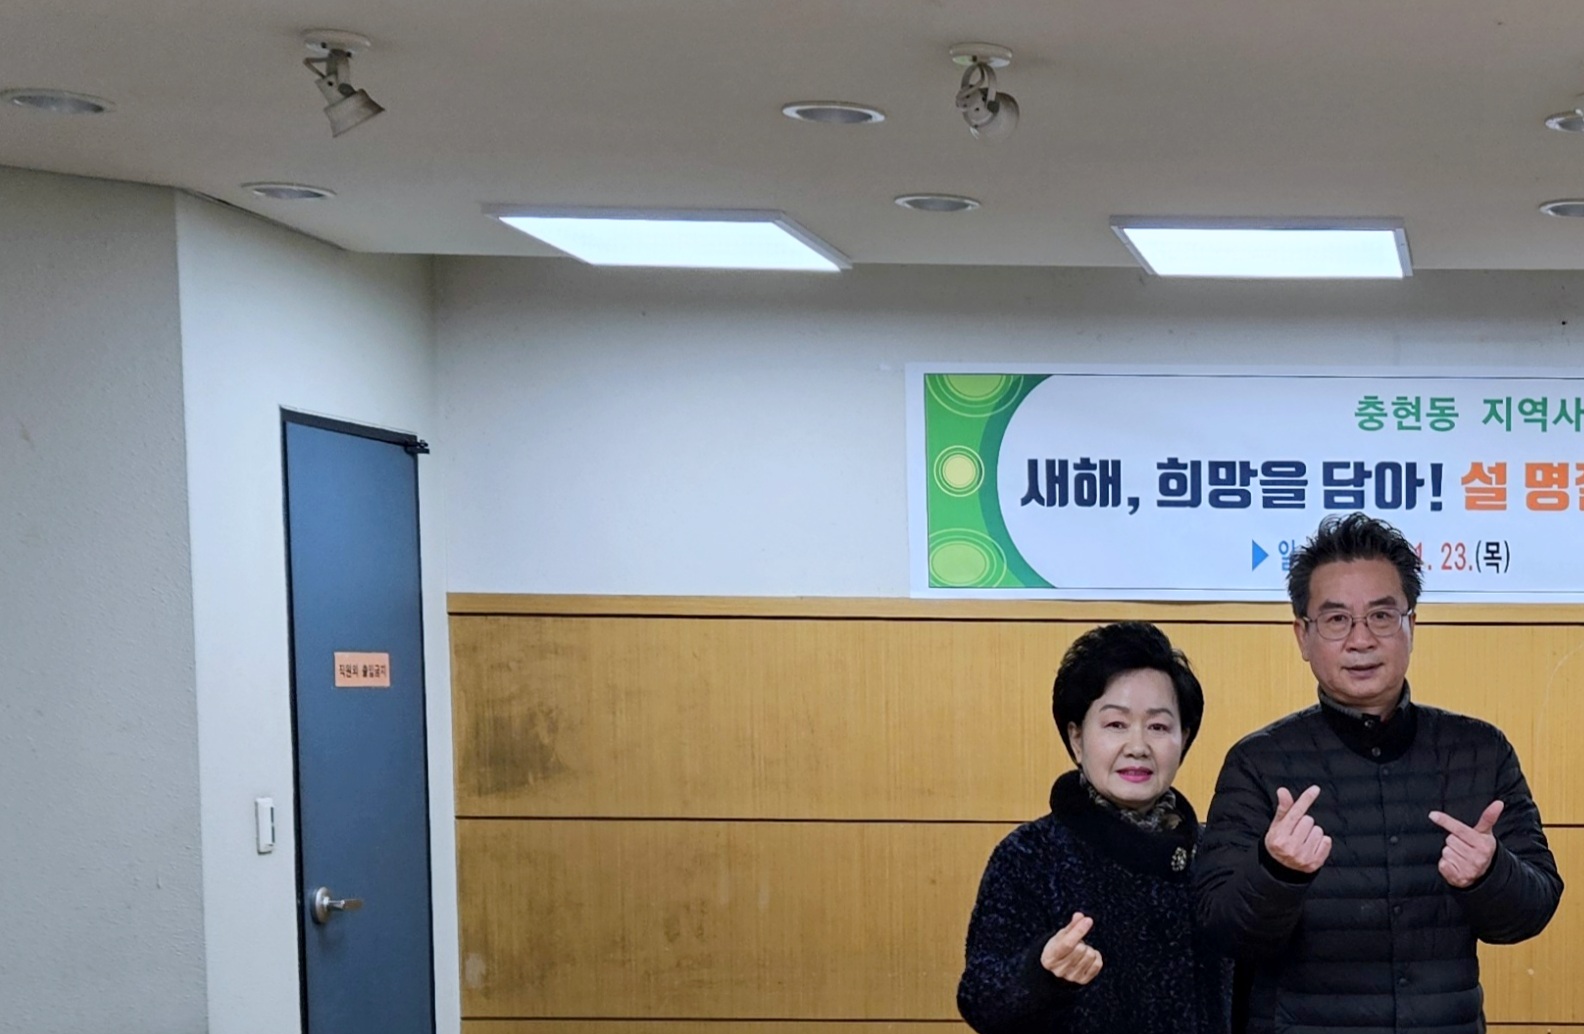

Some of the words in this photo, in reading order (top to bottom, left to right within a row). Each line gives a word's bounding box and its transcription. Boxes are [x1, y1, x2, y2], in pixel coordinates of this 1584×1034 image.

[1354, 395, 1459, 432] 충현동
[1020, 457, 1140, 515] 새해,
[1155, 457, 1309, 512] 희망을
[1321, 459, 1444, 512] 담아!
[1460, 461, 1508, 512] 설
